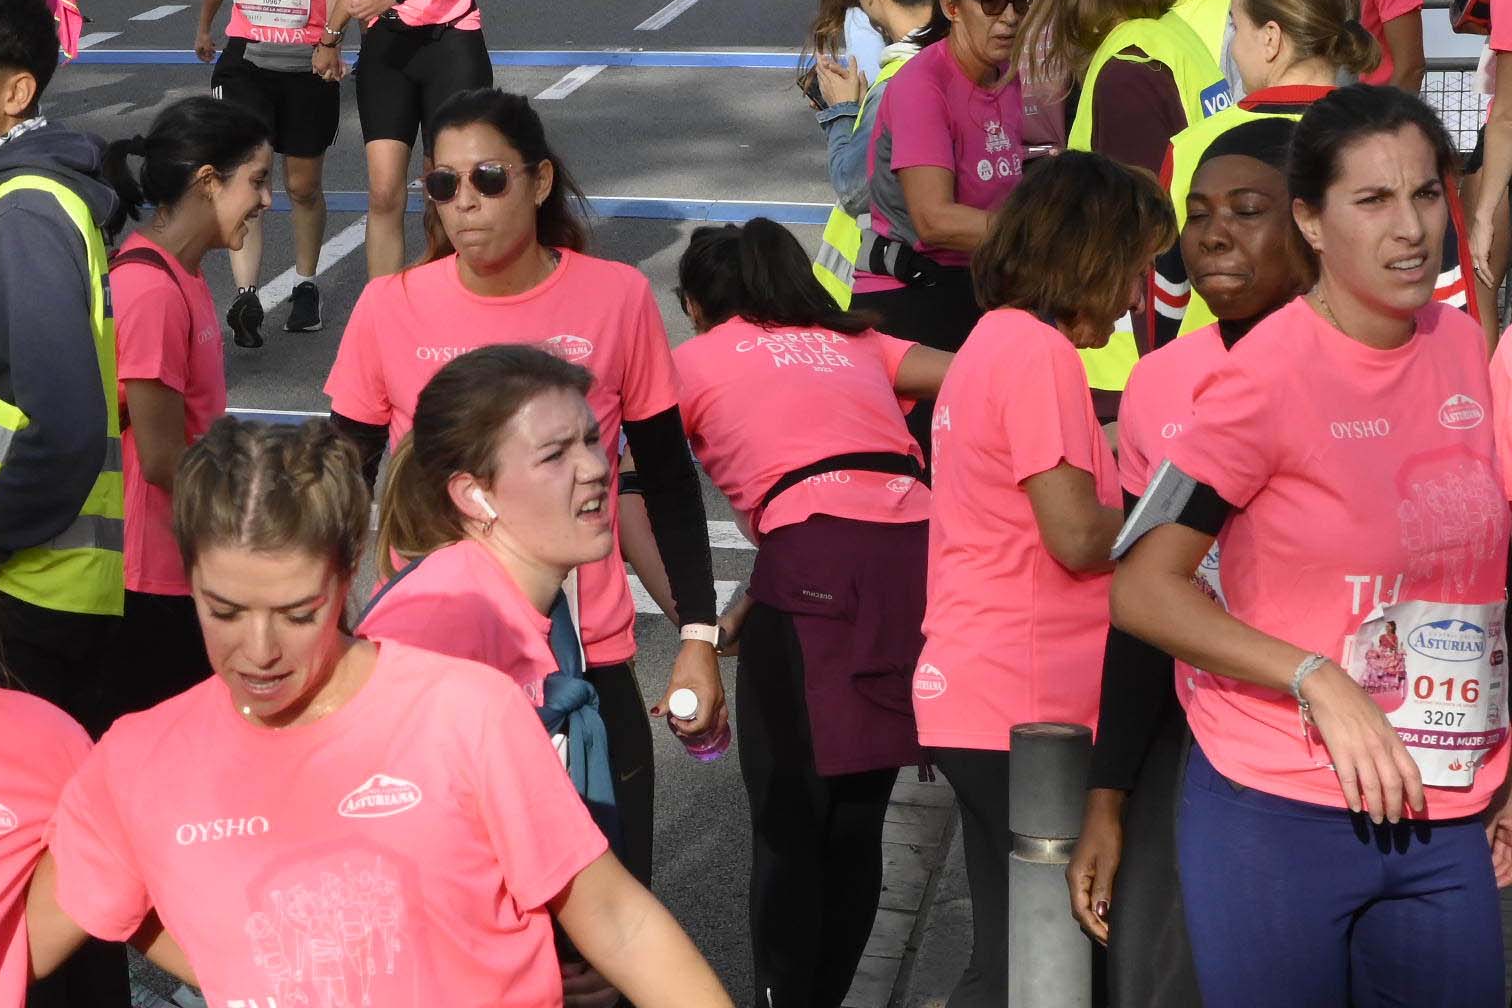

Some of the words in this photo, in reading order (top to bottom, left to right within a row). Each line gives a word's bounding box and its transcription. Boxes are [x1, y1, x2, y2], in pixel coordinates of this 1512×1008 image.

[250, 27, 304, 43] SUMA
[735, 331, 849, 354] CARRERA
[765, 341, 800, 354] DE
[808, 342, 840, 355] LA
[771, 352, 856, 369] MUJER
[1441, 406, 1481, 427] ASTURIANA
[1330, 417, 1390, 440] OYSHO
[1345, 573, 1405, 617] TU
[1413, 674, 1481, 704] 016
[1423, 709, 1467, 728] 3207
[1421, 735, 1438, 745] DE
[1439, 736, 1455, 746] LA
[176, 815, 269, 846] OYSHO
